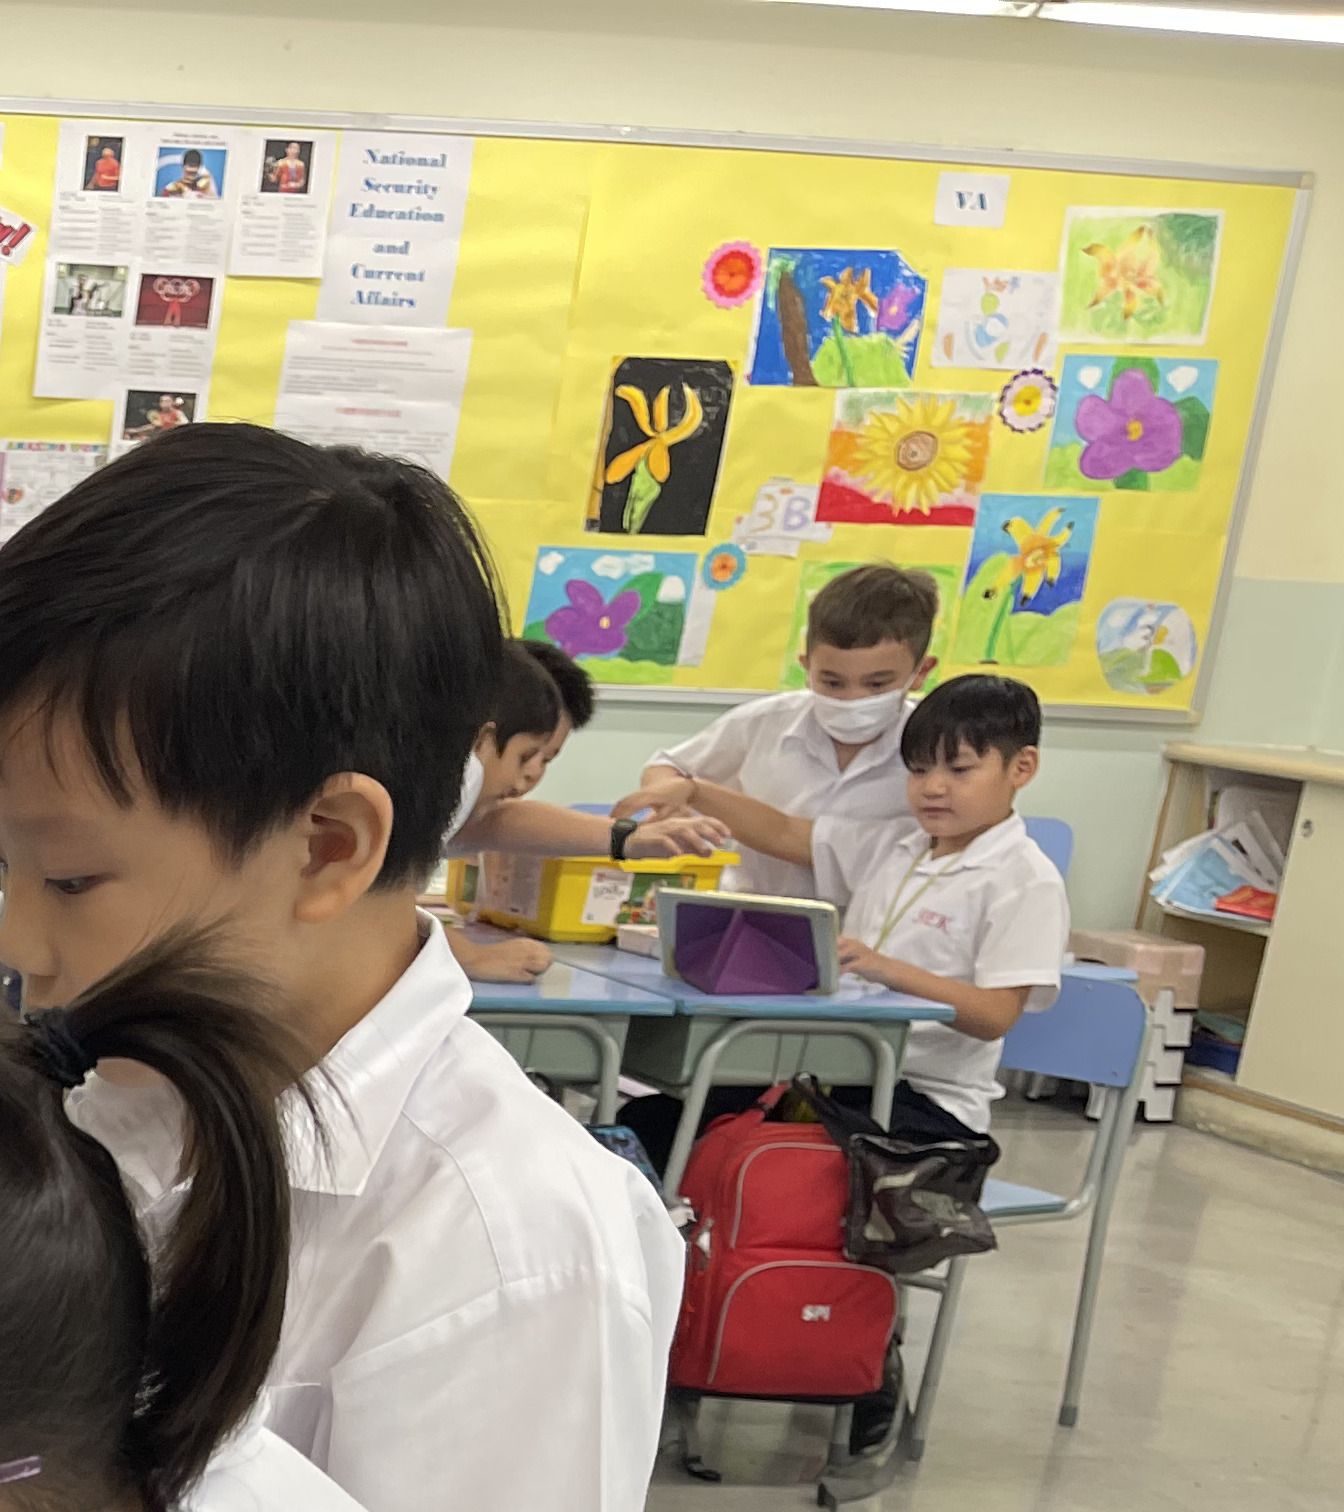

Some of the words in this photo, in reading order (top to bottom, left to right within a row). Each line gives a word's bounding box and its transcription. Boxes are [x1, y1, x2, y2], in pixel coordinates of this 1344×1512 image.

[363, 149, 447, 168] National
[362, 177, 440, 200] Security
[954, 190, 989, 211] VA
[349, 203, 445, 222] Education
[372, 240, 410, 255] and
[351, 263, 425, 282] Current
[351, 290, 417, 308] Affairs
